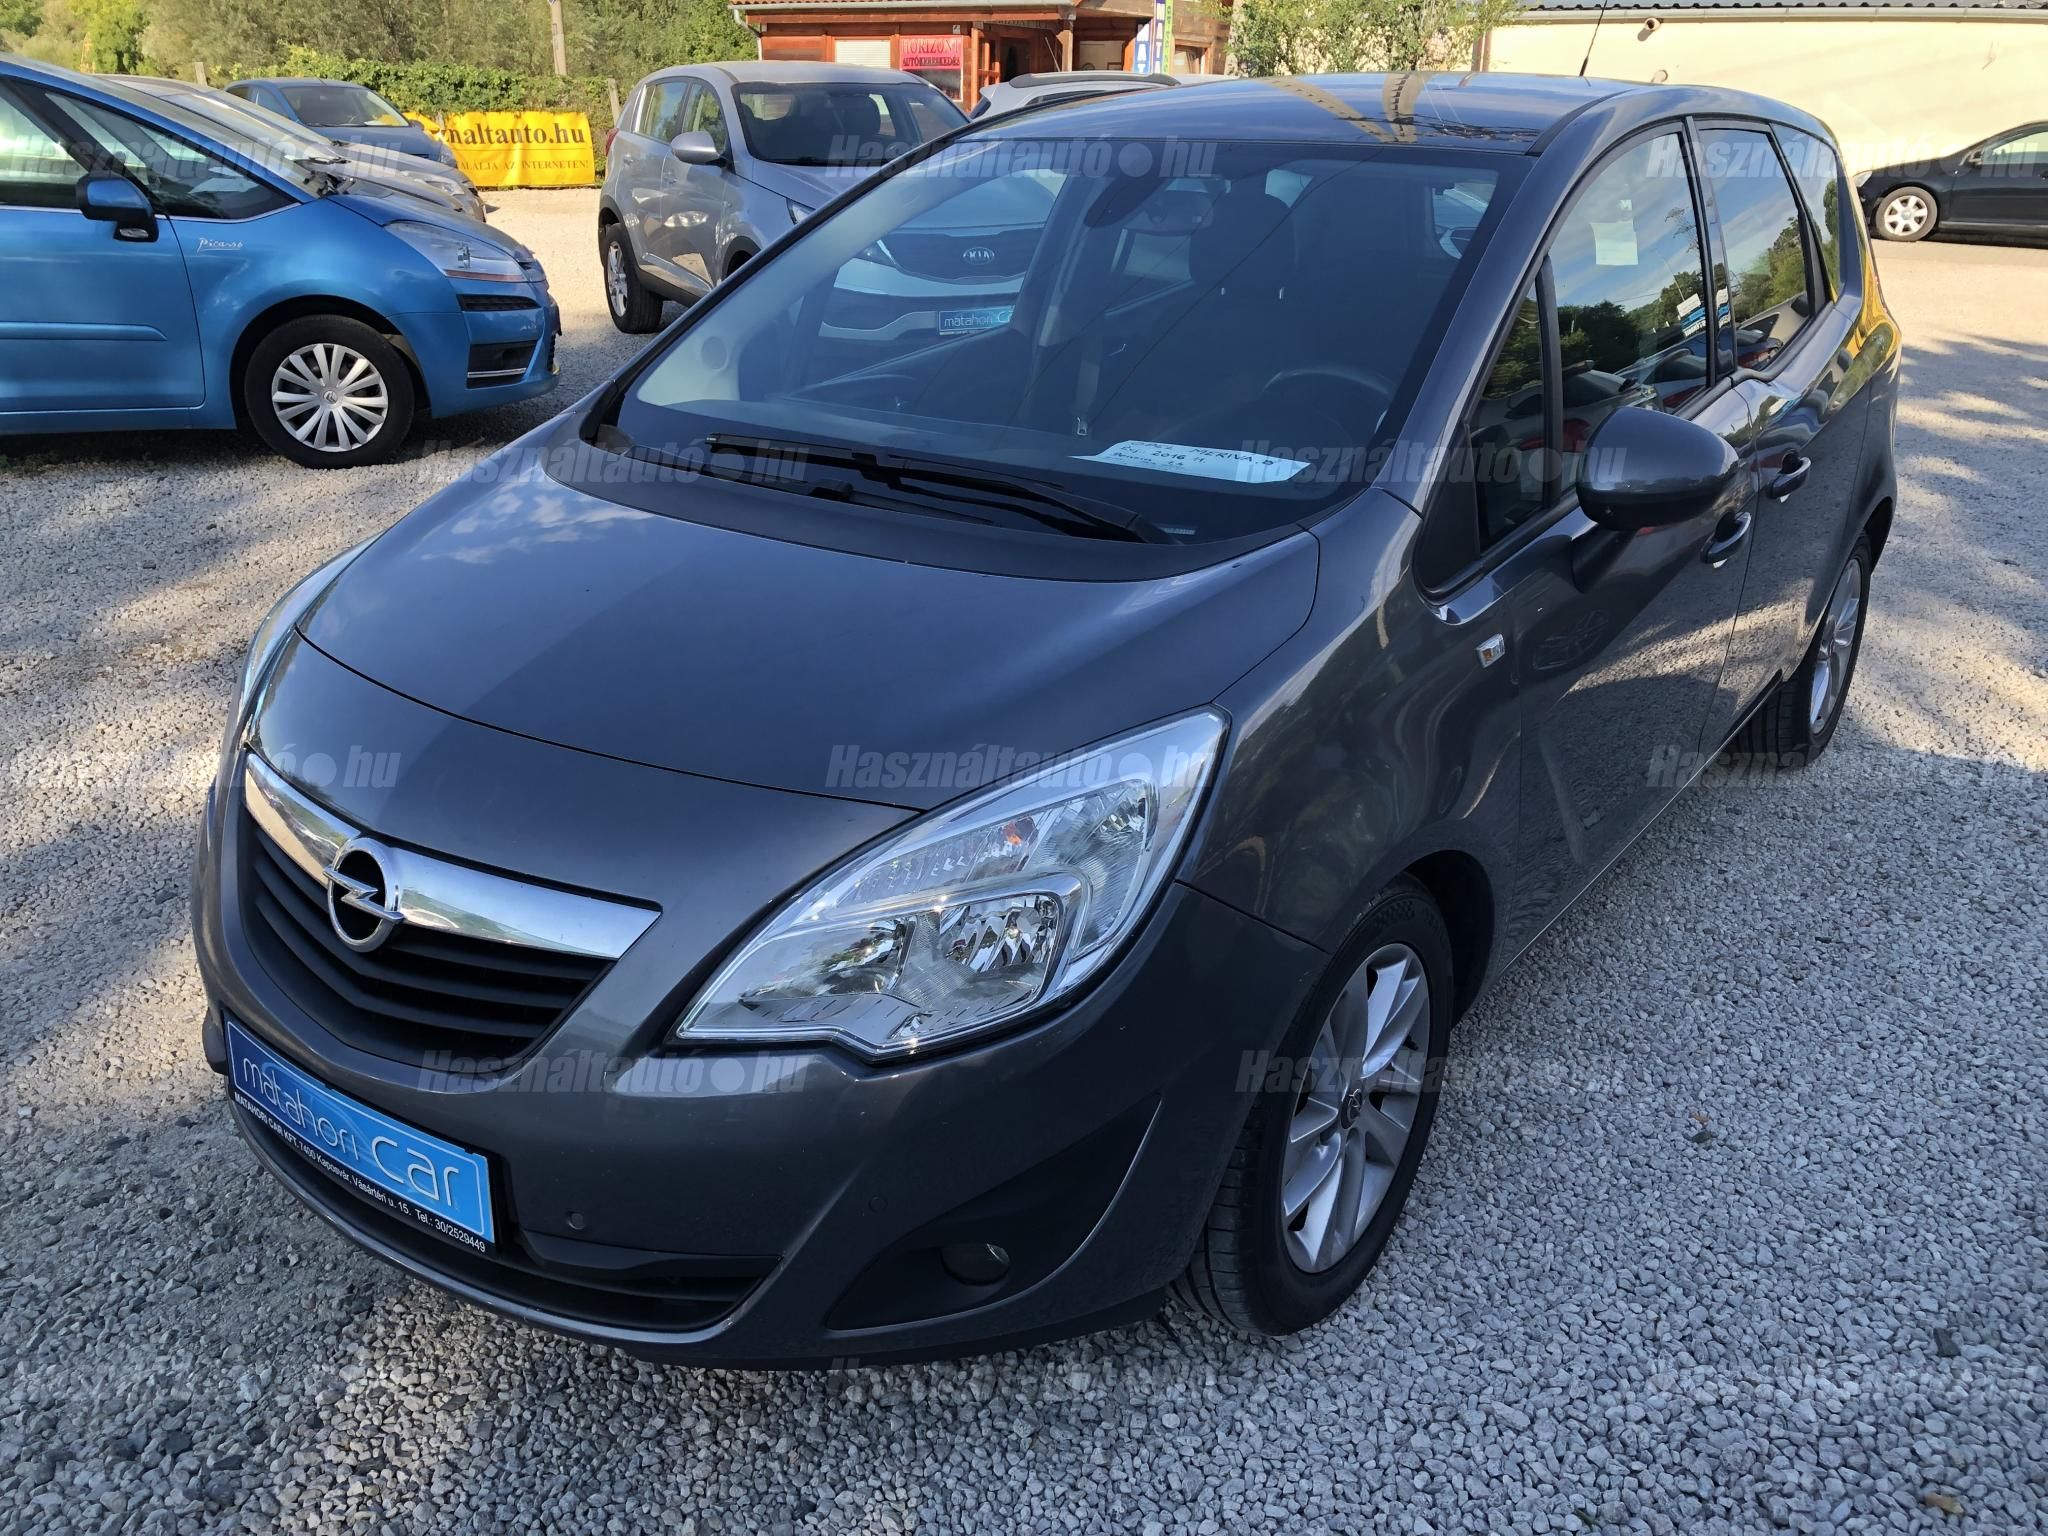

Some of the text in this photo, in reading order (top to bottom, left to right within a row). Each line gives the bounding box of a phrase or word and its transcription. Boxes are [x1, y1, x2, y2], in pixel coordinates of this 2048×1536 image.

[197, 237, 243, 255] Picasso
[234, 1091, 268, 1124] MATAHORI
[268, 1117, 283, 1137] CAR
[299, 1141, 316, 1160] 7400
[398, 1201, 412, 1216] 15.
[435, 1218, 486, 1253] 30/2529449
